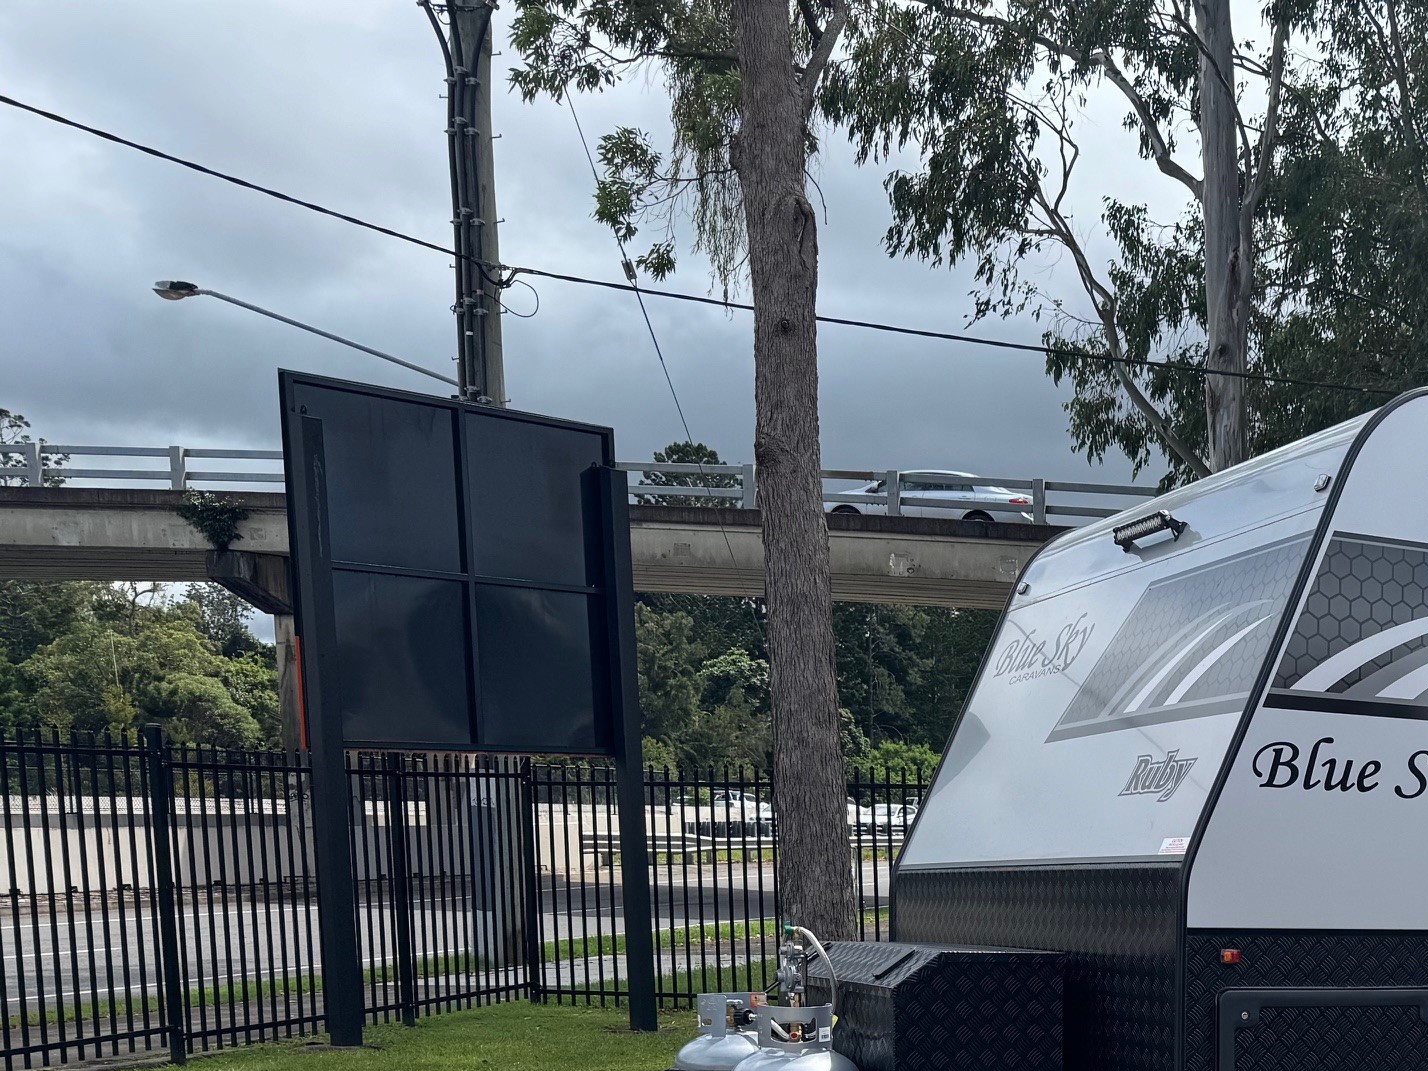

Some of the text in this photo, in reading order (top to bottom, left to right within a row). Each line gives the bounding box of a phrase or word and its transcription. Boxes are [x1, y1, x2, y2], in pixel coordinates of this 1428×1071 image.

[993, 612, 1095, 678] Blue Sky
[1008, 664, 1061, 685] CARAVANS
[1117, 749, 1198, 802] Ruby
[1252, 737, 1381, 792] Blue
